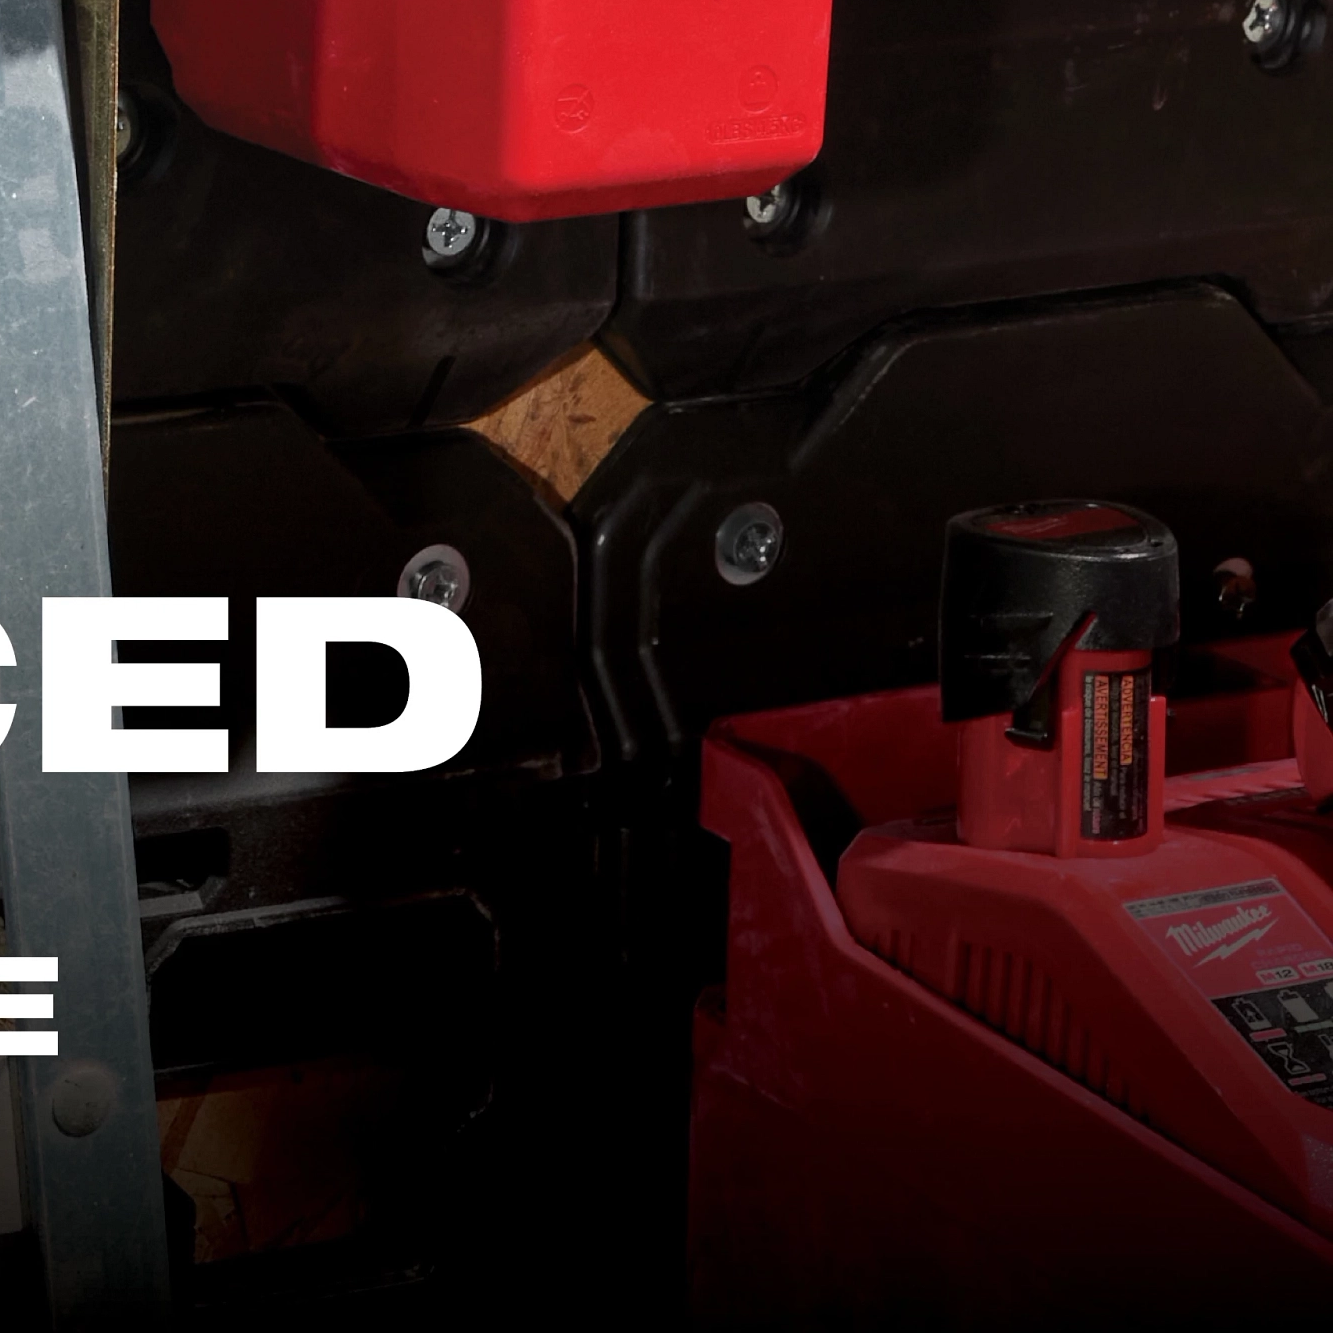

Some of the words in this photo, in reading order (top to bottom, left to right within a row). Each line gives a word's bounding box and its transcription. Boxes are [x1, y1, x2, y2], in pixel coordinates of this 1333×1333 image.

[1095, 679, 1107, 776] AVERTISSEMENT
[1122, 679, 1132, 762] ADVERTENCIA
[1166, 903, 1272, 956] Milwaukee
